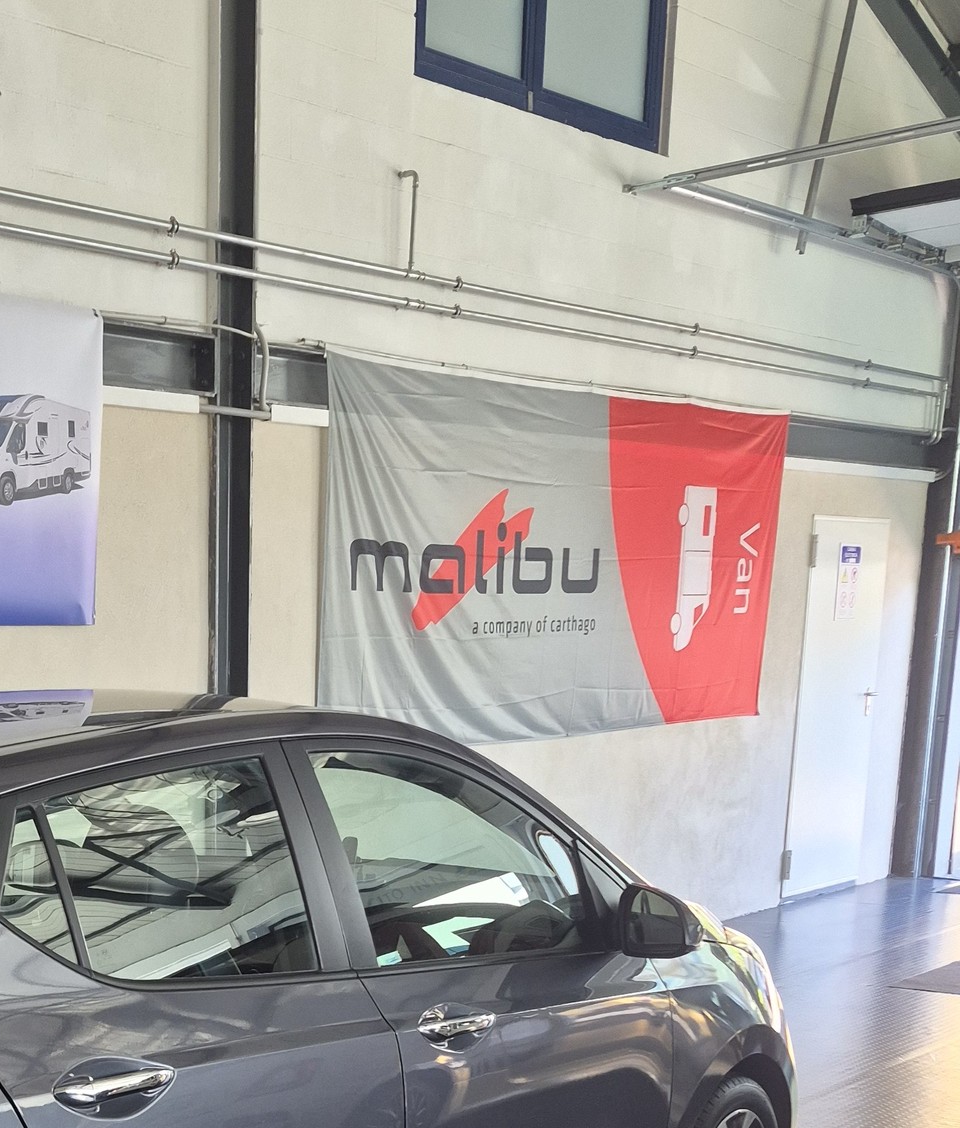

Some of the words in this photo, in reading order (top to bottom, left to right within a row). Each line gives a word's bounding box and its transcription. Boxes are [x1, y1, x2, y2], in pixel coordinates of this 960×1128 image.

[349, 522, 601, 595] malibu
[472, 621, 479, 635] a
[483, 620, 532, 638] company
[536, 615, 548, 633] of
[550, 615, 596, 636] carthago
